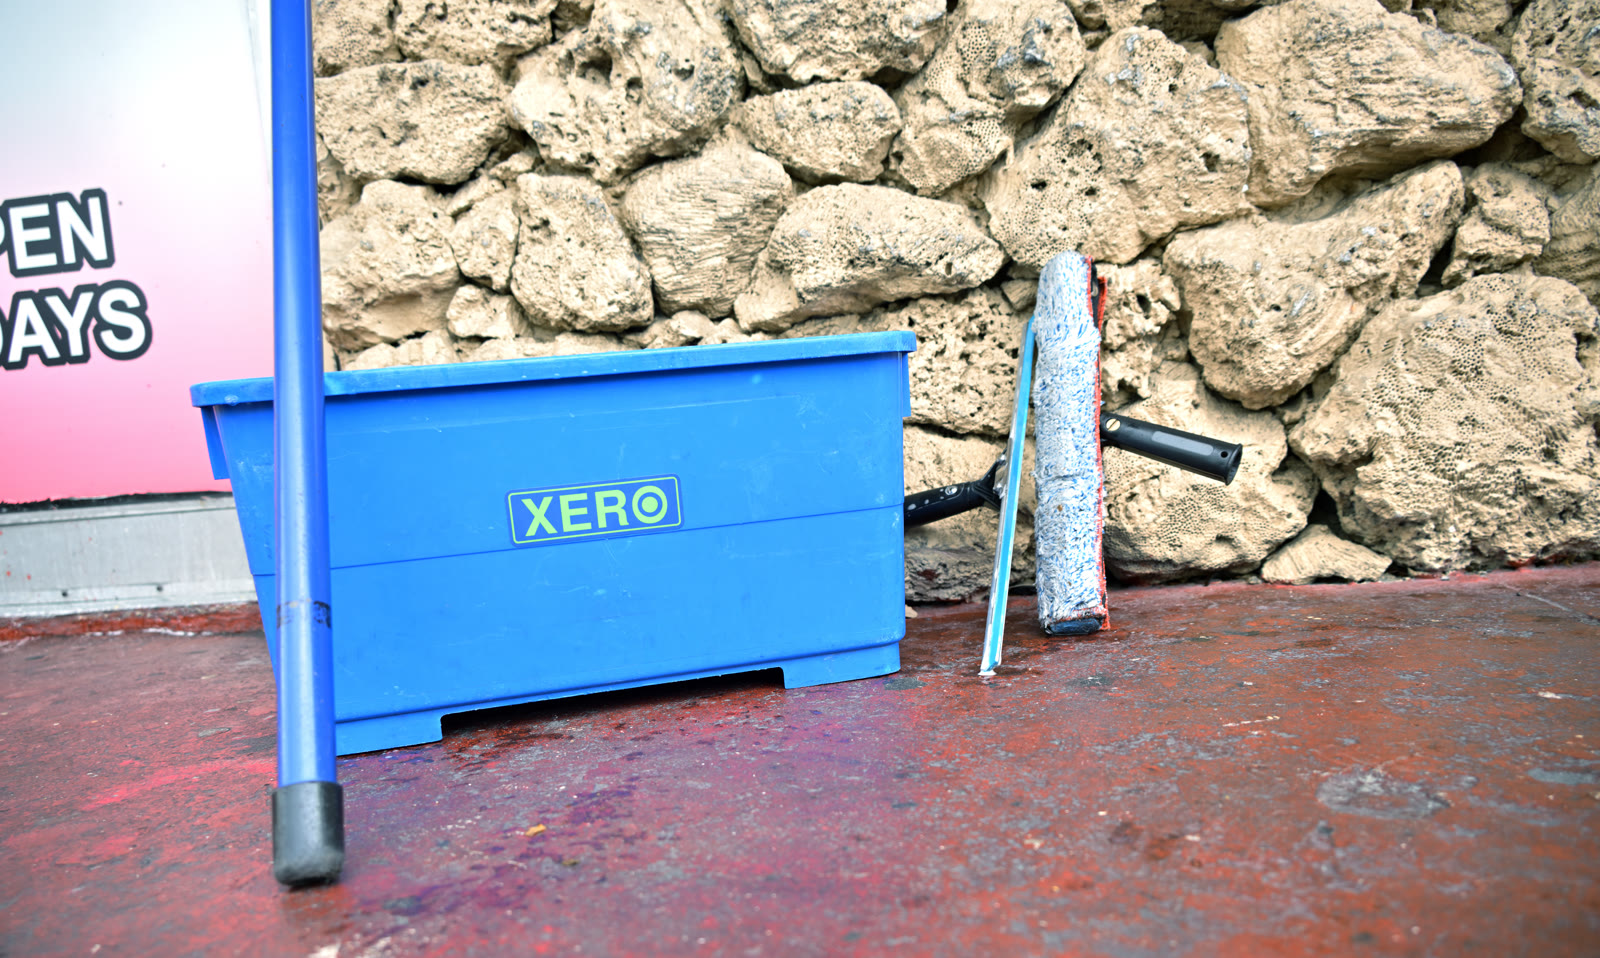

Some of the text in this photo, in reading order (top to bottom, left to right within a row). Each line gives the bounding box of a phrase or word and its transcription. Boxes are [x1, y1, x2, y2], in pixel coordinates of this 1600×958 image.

[0, 190, 112, 274] EN
[0, 282, 151, 368] AYS
[520, 484, 669, 538] XERO
